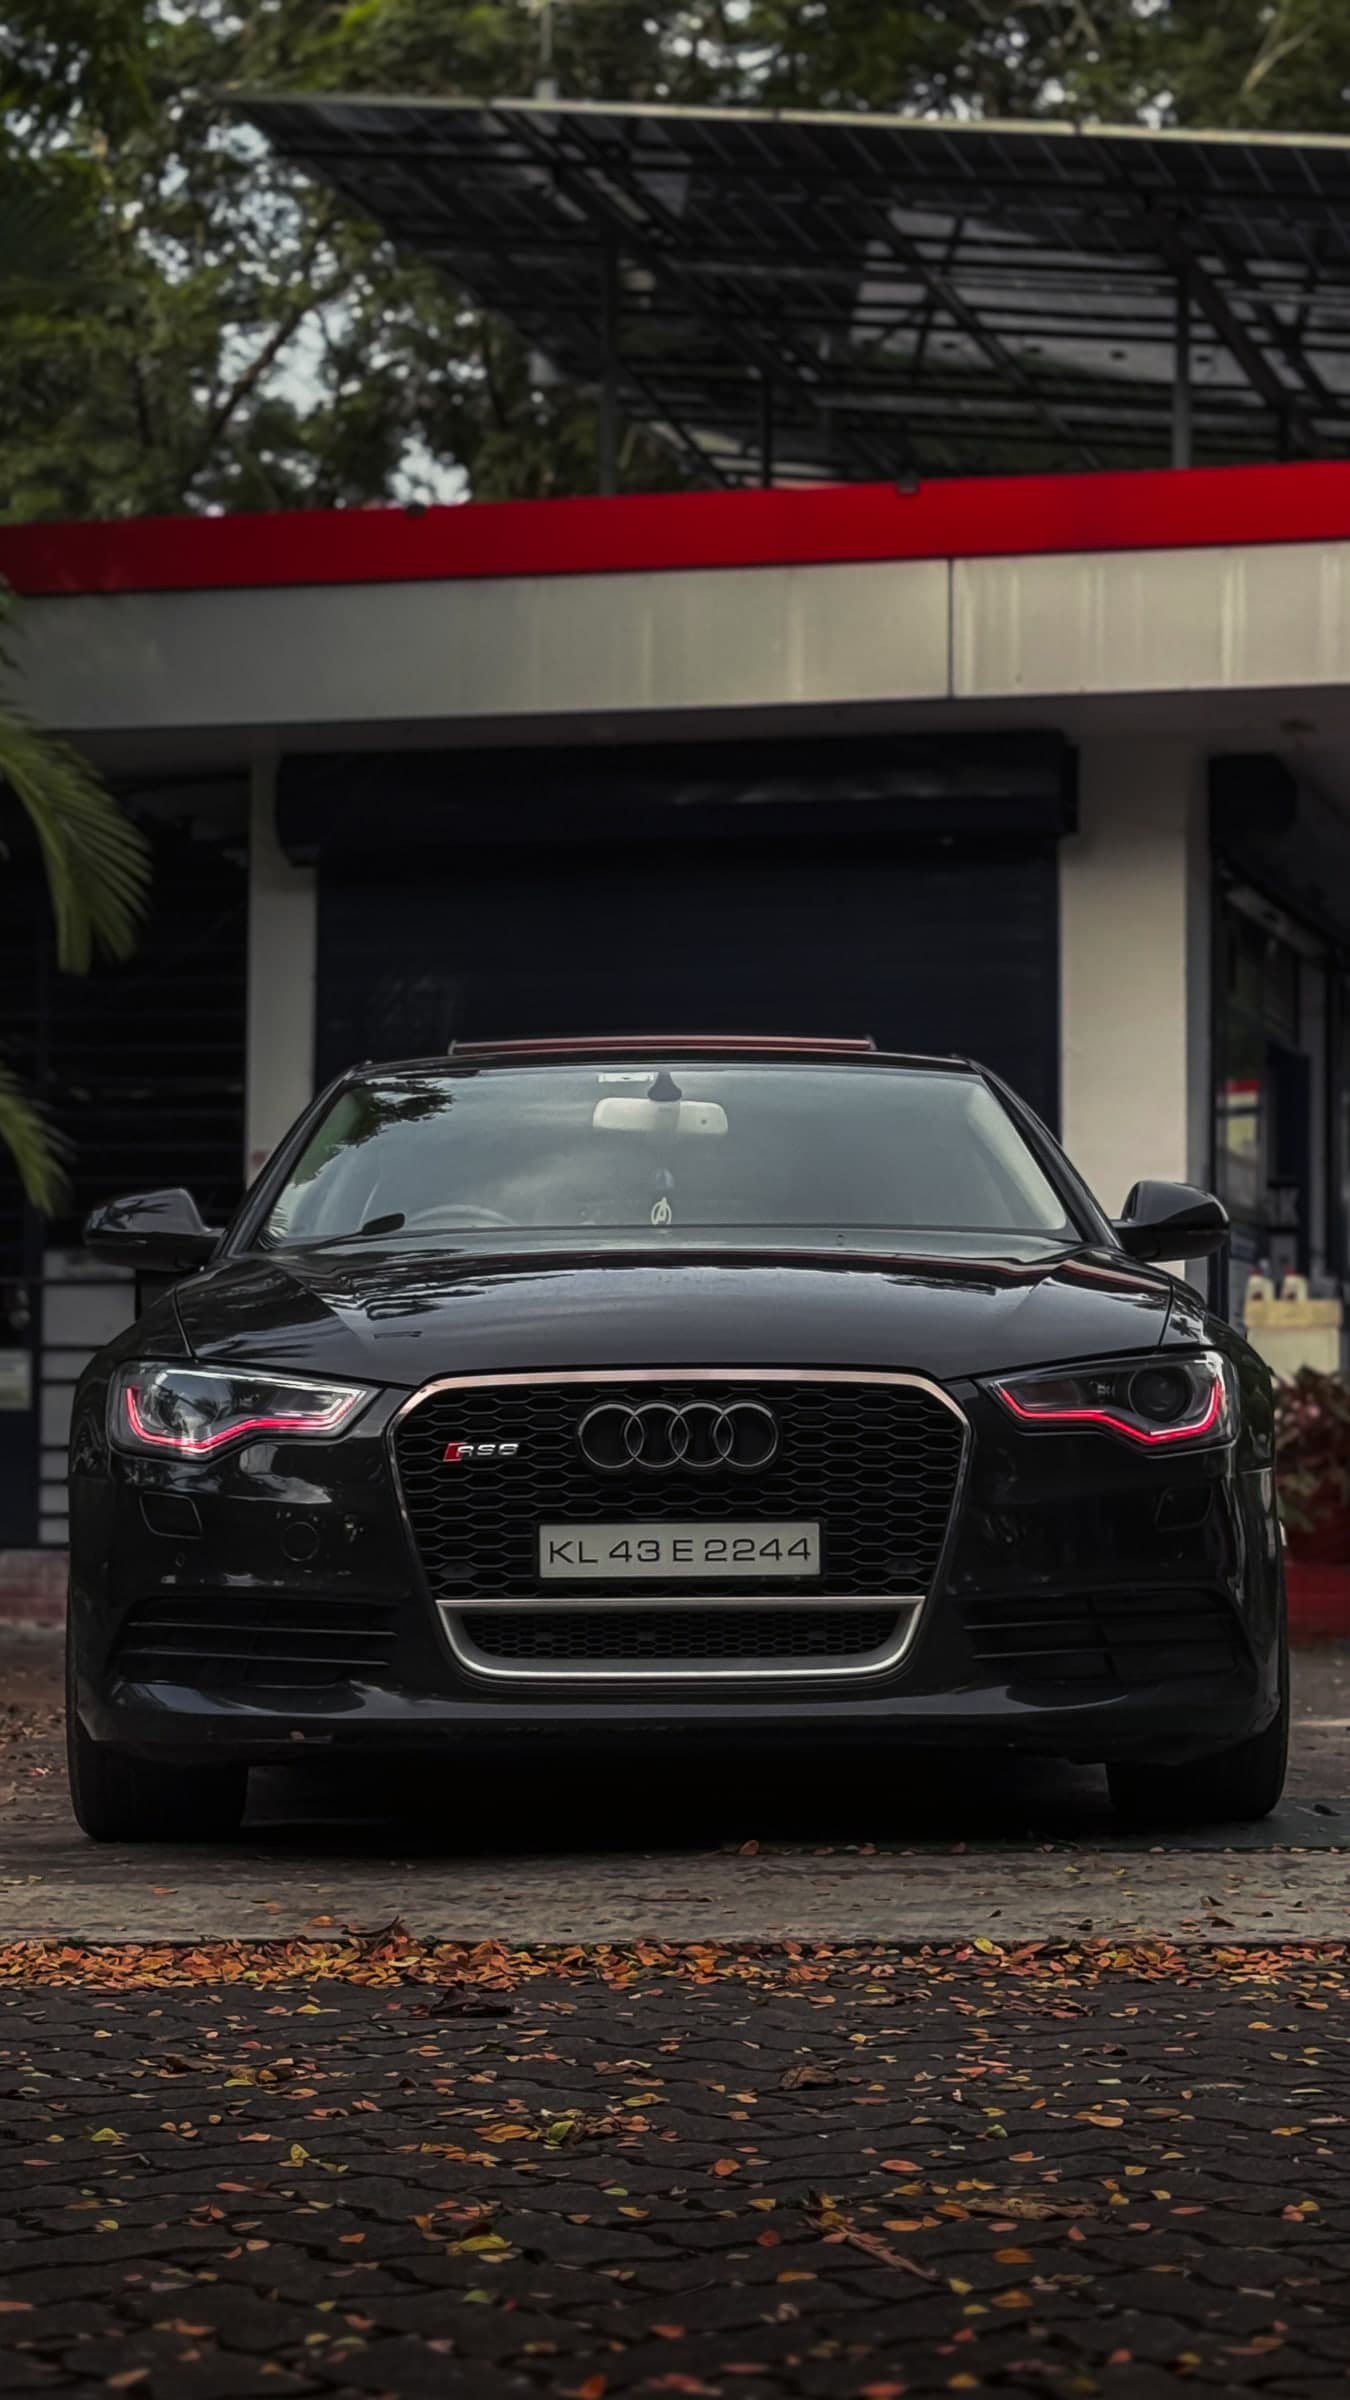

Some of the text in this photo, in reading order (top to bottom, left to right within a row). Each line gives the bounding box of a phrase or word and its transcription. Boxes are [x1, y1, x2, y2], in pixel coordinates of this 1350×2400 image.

[455, 1443, 519, 1458] RS6
[549, 1538, 811, 1563] KL 43 E 2244
